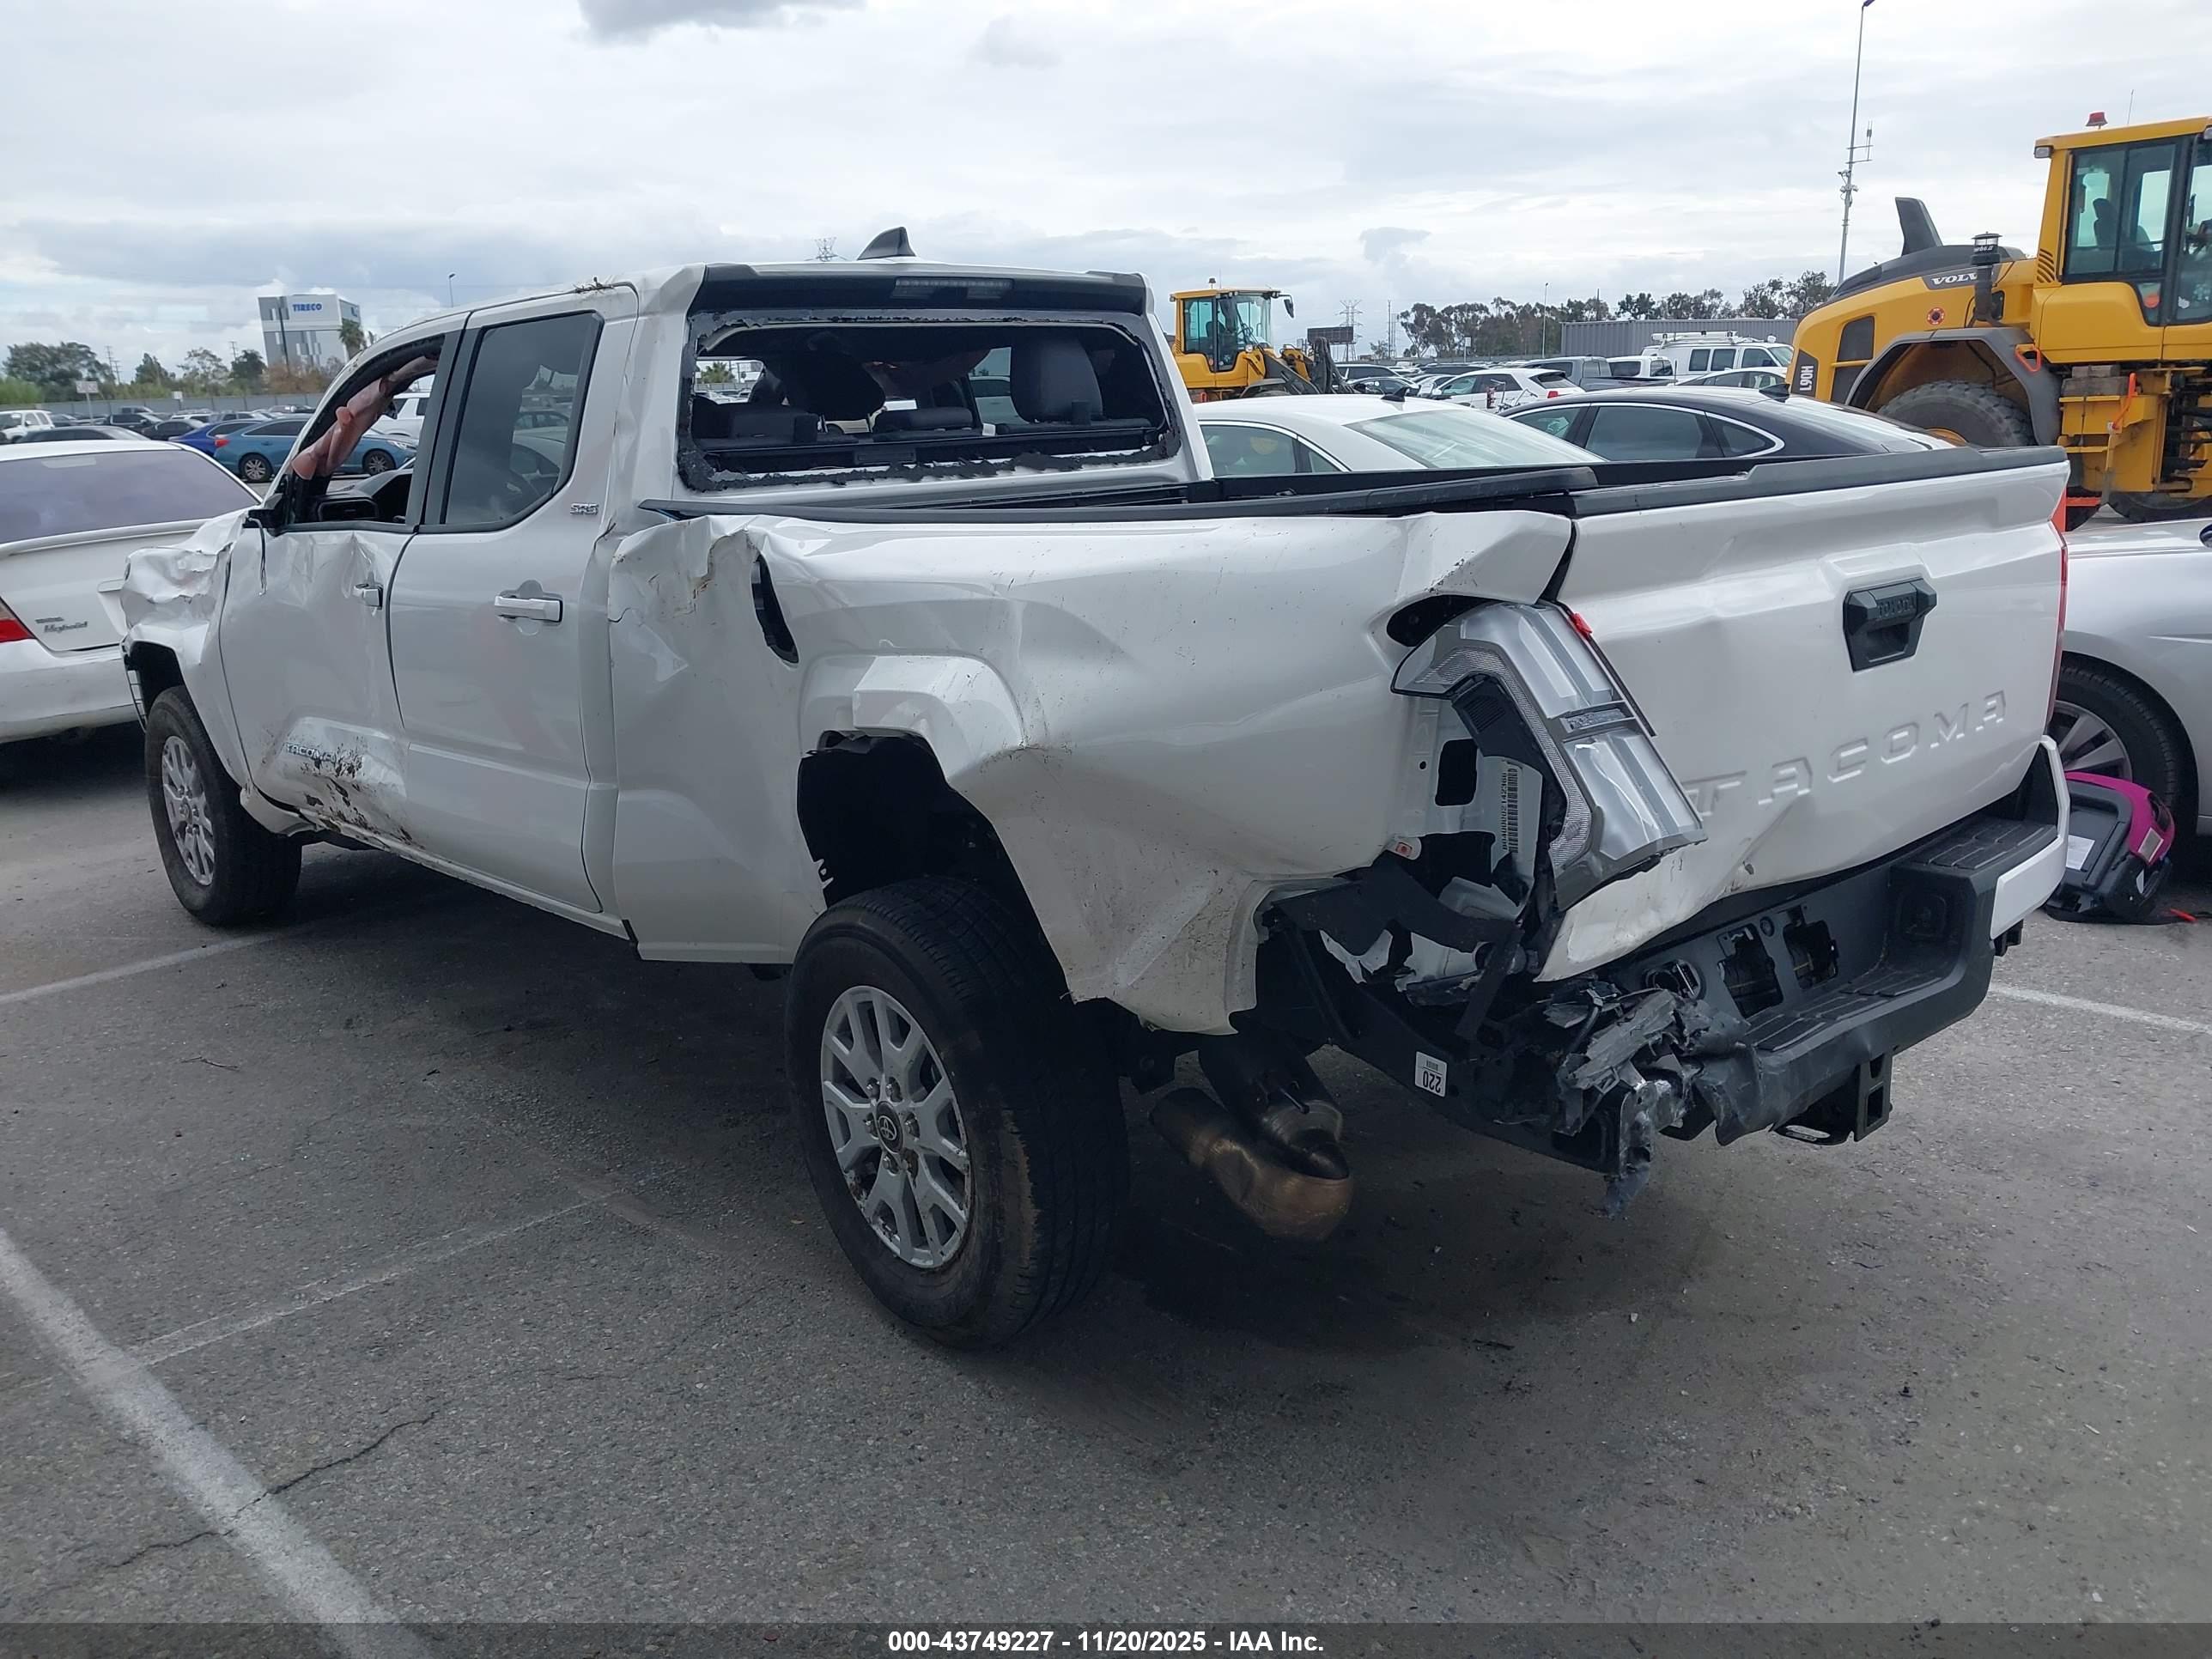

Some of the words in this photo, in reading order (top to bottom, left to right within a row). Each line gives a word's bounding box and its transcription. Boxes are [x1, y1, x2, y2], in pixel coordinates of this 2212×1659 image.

[1931, 272, 1978, 285] VOLV
[293, 303, 323, 313] TIRECO
[1799, 365, 1814, 391] L90H
[1681, 690, 2007, 817] TACOMA
[1423, 1070, 1442, 1093] 220
